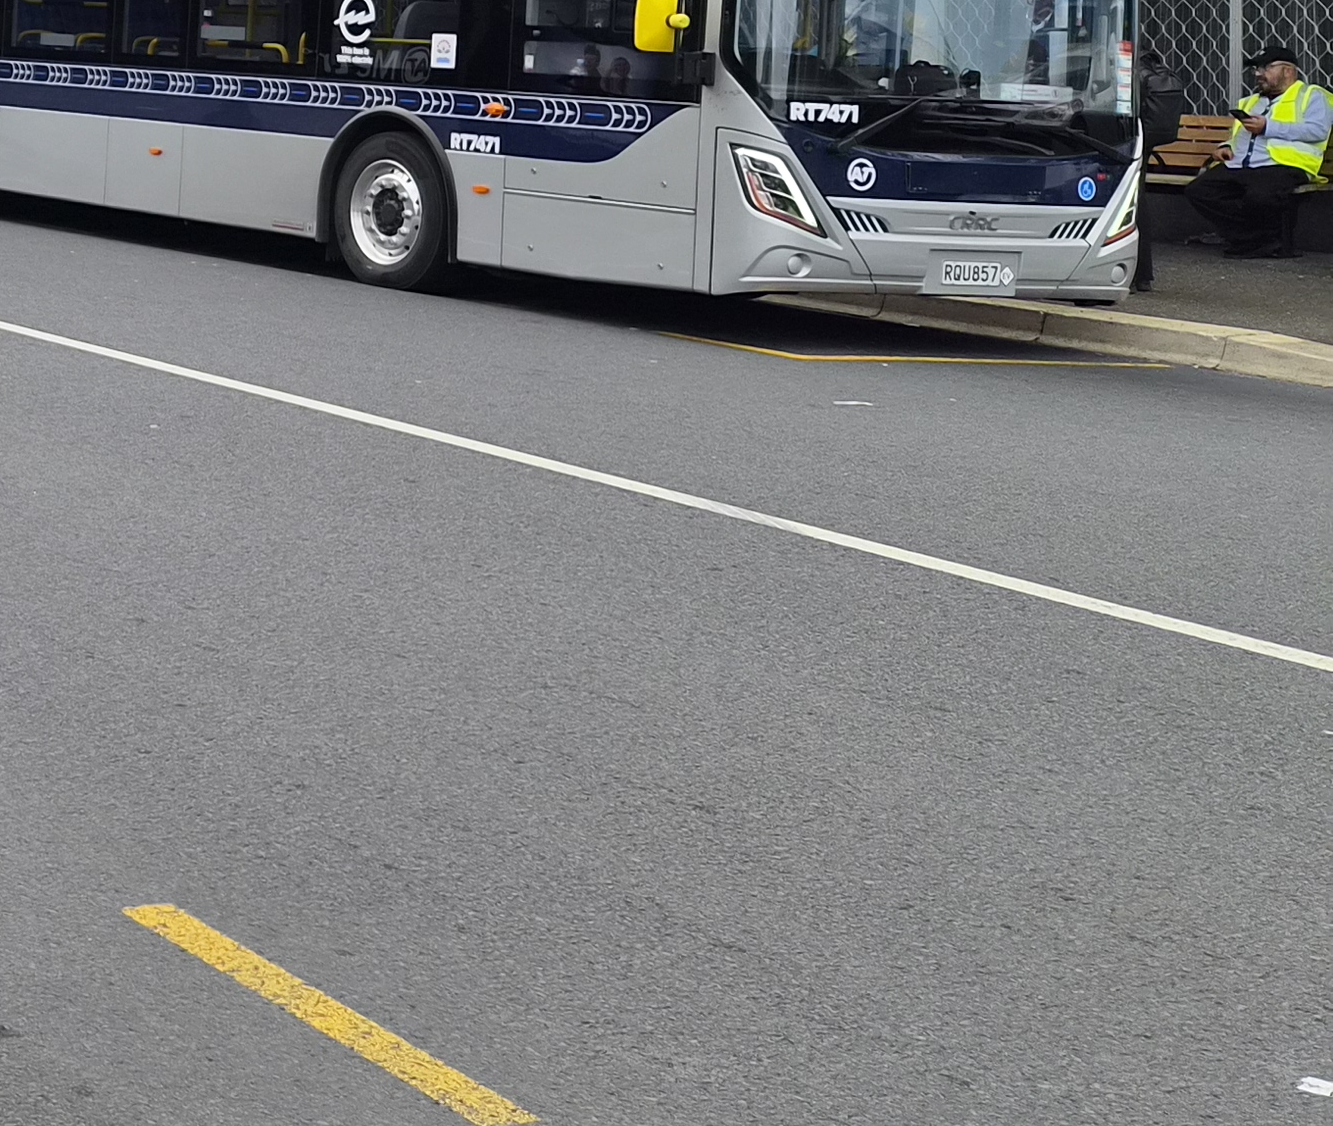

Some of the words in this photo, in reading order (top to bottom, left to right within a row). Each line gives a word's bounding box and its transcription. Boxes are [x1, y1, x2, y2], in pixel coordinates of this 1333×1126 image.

[789, 101, 860, 124] RT7471
[450, 131, 501, 154] RT7471
[949, 215, 1000, 231] CRRC
[944, 264, 999, 282] RQU857
